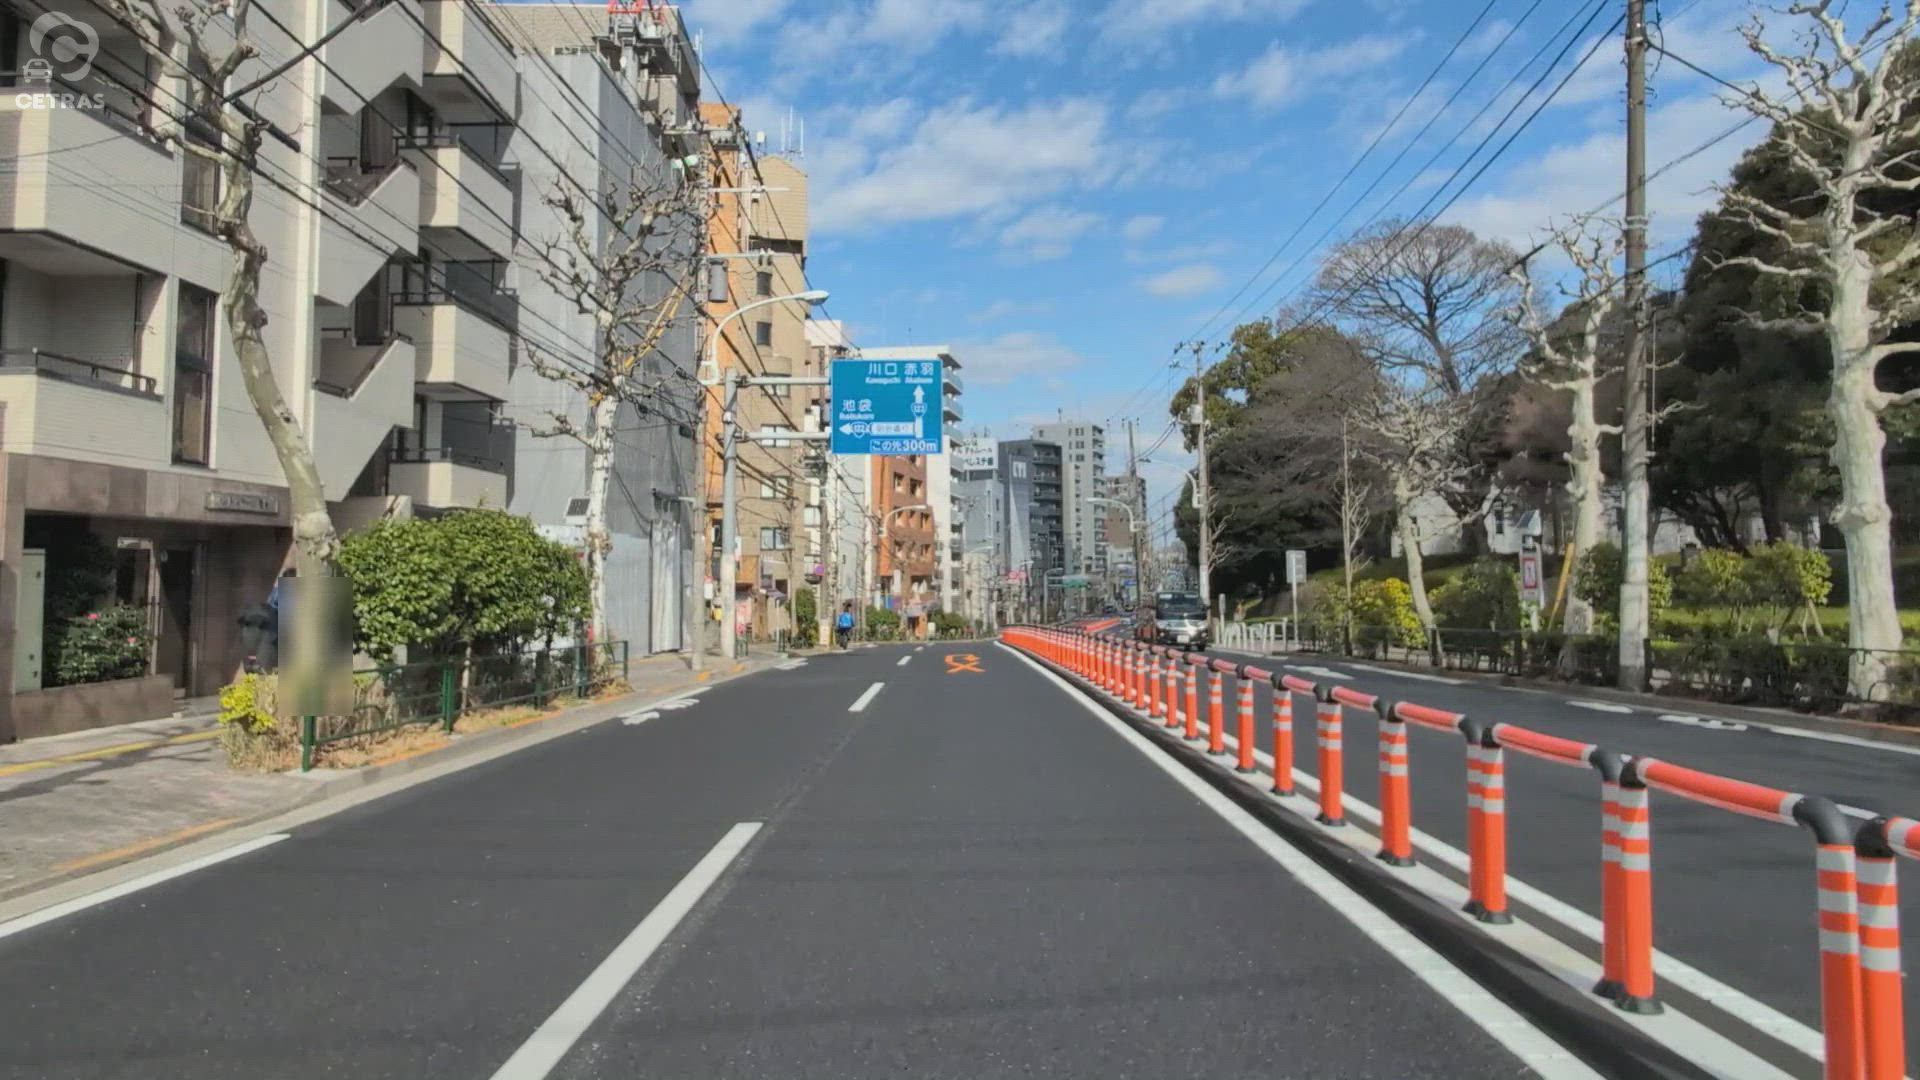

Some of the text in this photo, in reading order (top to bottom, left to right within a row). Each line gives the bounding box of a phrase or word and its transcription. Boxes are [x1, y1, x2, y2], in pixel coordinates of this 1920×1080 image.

[868, 362, 934, 376] 川口 赤羽
[842, 399, 872, 412] 池袋
